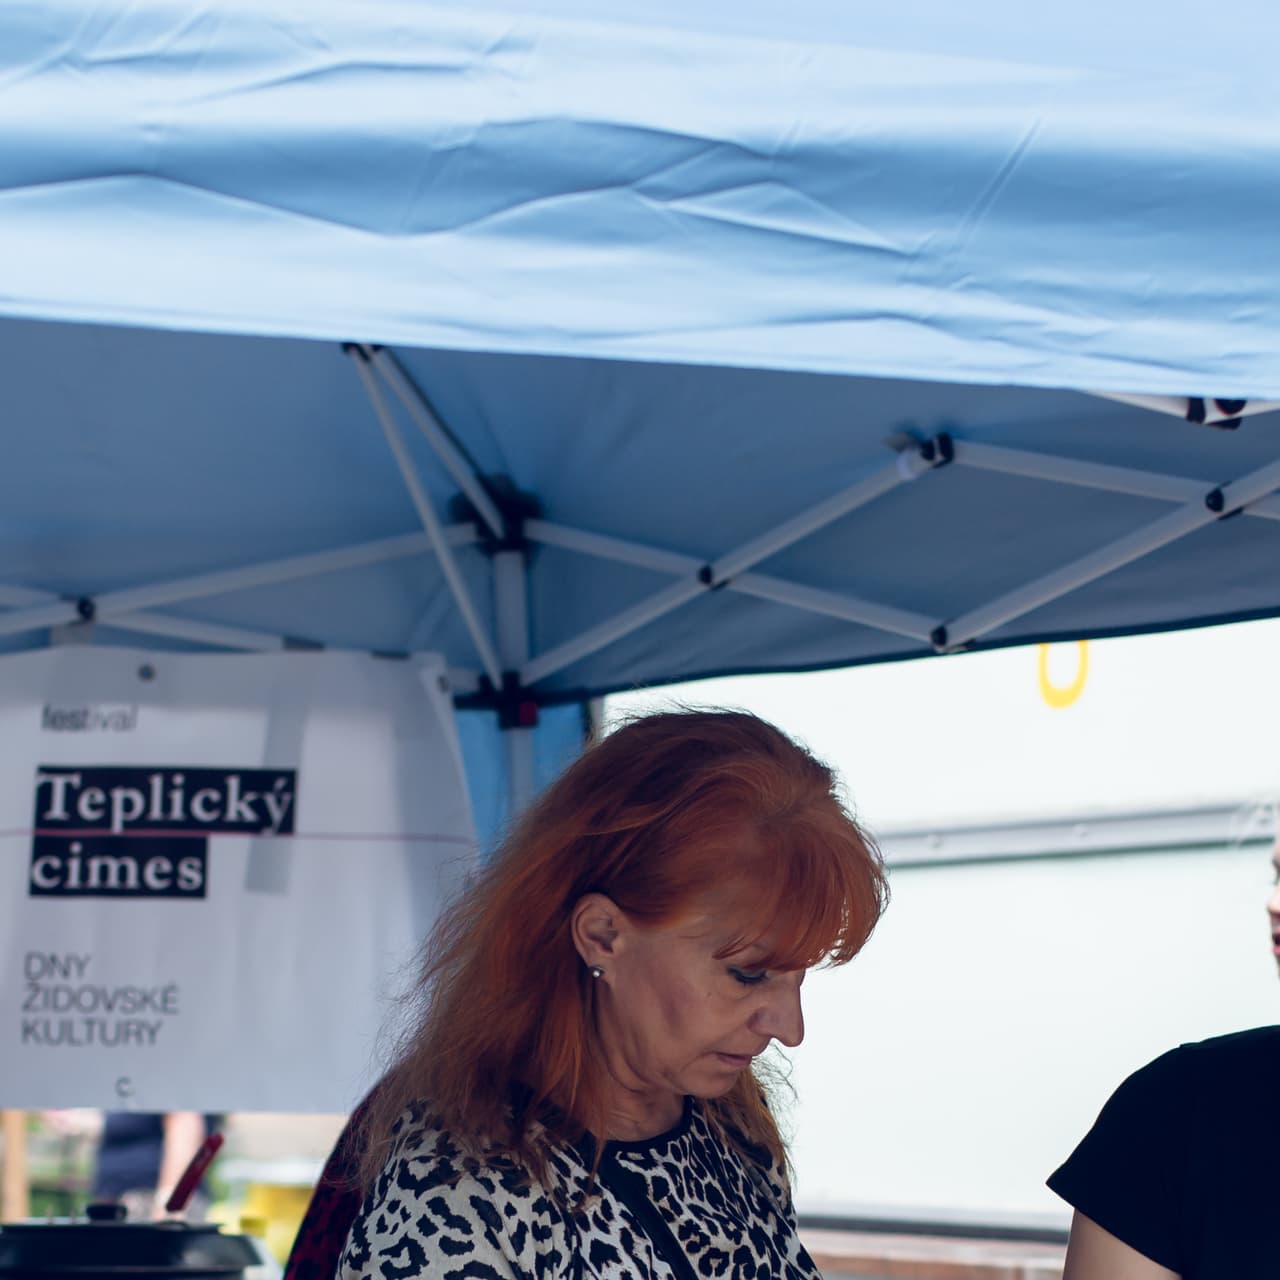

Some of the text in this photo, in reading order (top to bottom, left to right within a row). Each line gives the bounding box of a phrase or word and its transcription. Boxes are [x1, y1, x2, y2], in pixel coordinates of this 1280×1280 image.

[40, 772, 292, 836] Teplický
[31, 841, 204, 889] cimes
[24, 951, 92, 980] DNY
[23, 982, 179, 1014] ŽIDOVSKÉ
[22, 1018, 164, 1046] KULTURY
